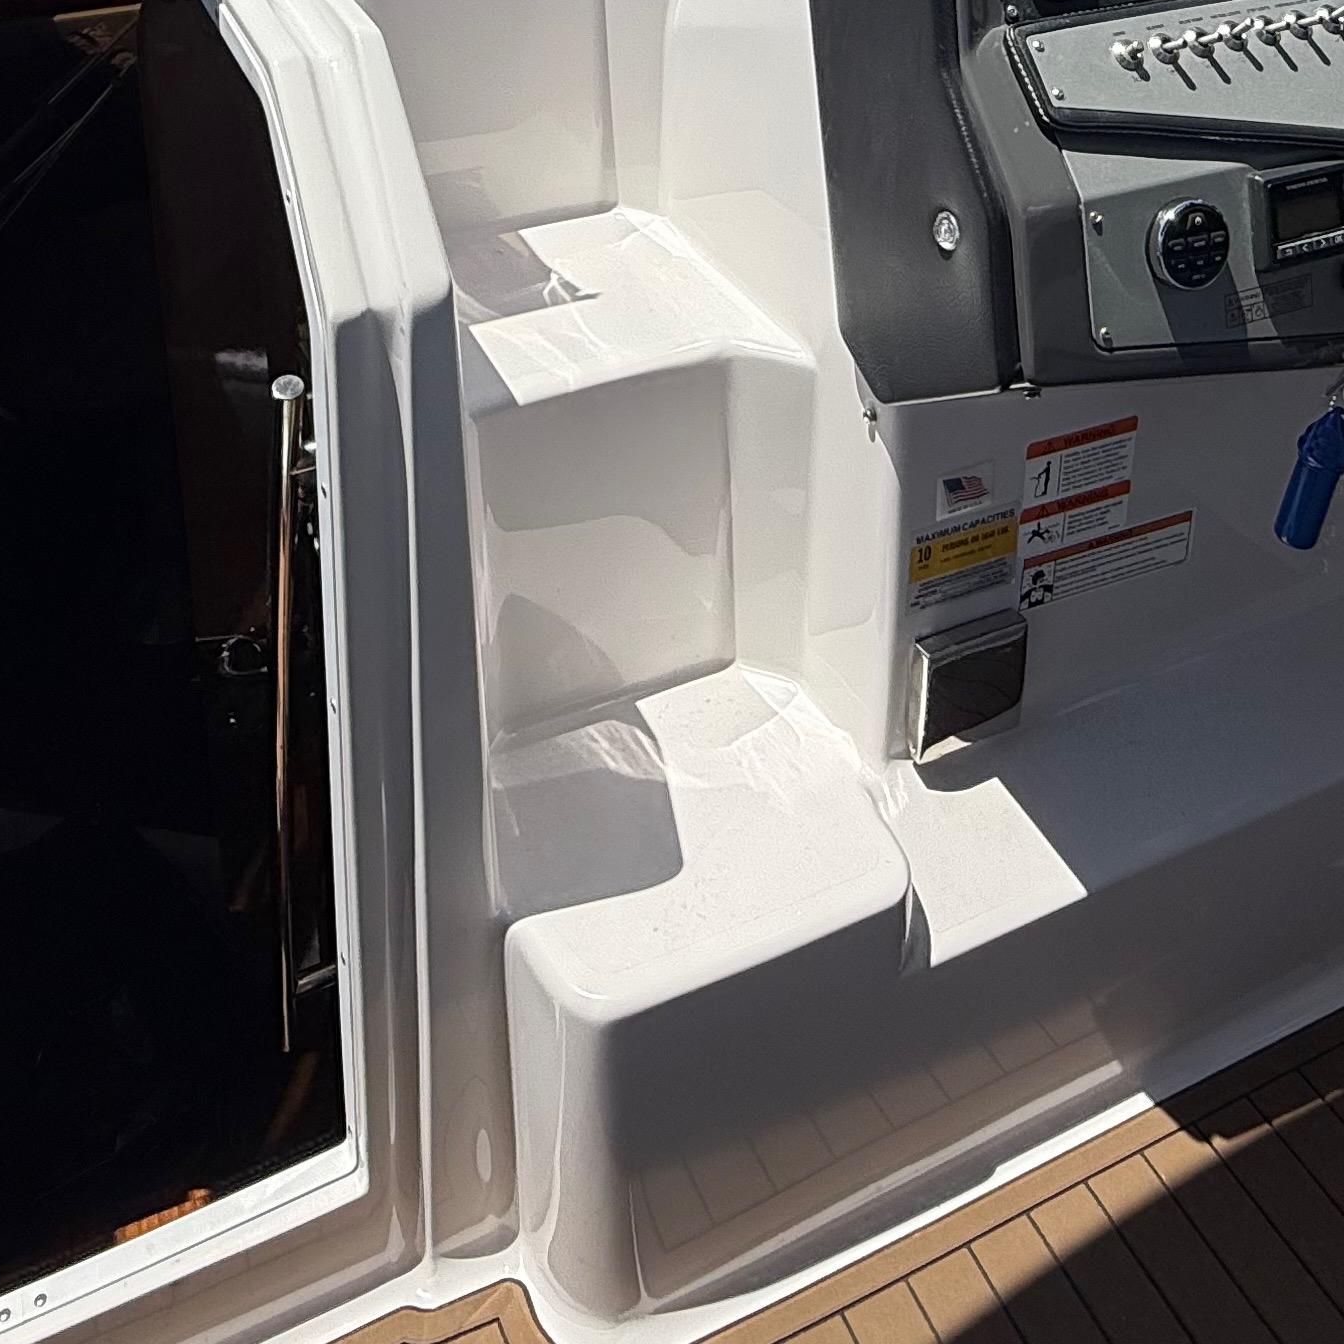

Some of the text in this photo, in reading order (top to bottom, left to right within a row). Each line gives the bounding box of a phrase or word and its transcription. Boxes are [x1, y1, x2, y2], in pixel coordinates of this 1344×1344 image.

[1063, 423, 1114, 446] WARNING
[1057, 489, 1108, 512] WARNING
[916, 508, 1015, 544] MAXIMUM CAPACITIES
[918, 545, 932, 563] 10
[942, 538, 969, 552] PERSONS
